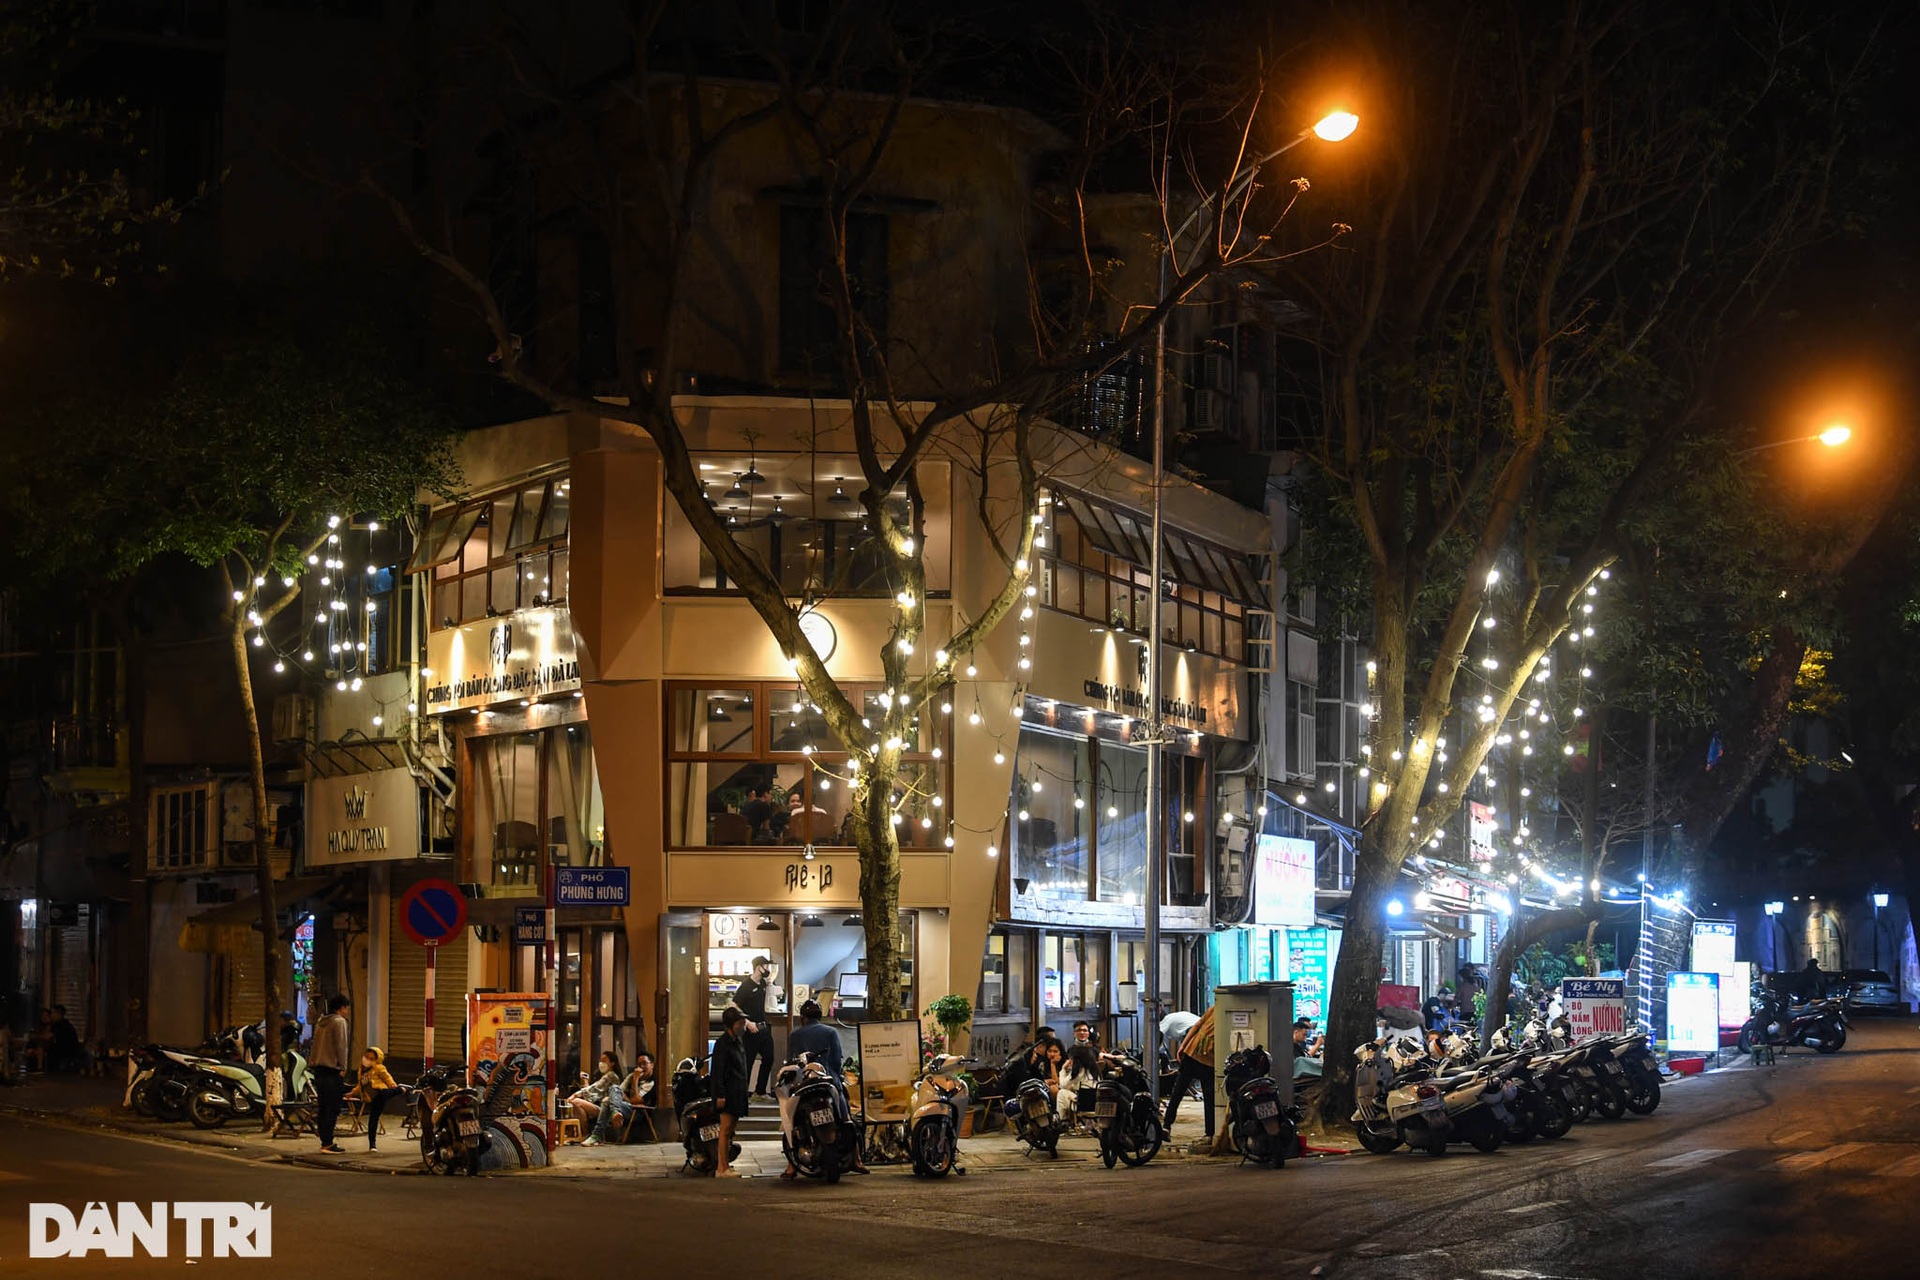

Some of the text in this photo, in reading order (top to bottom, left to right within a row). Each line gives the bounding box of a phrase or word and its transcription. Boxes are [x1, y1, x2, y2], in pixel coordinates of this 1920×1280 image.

[427, 681, 451, 704] CHÚNG
[466, 675, 482, 697] BÁN
[513, 668, 531, 692] ĐẶC
[580, 871, 604, 882] PHỐ
[561, 883, 624, 900] PHÙNG HƯNG
[525, 912, 537, 922] PHỐ
[1570, 981, 1616, 994] Bé Ny
[1571, 1000, 1622, 1032] BÒ NƯỚNG
